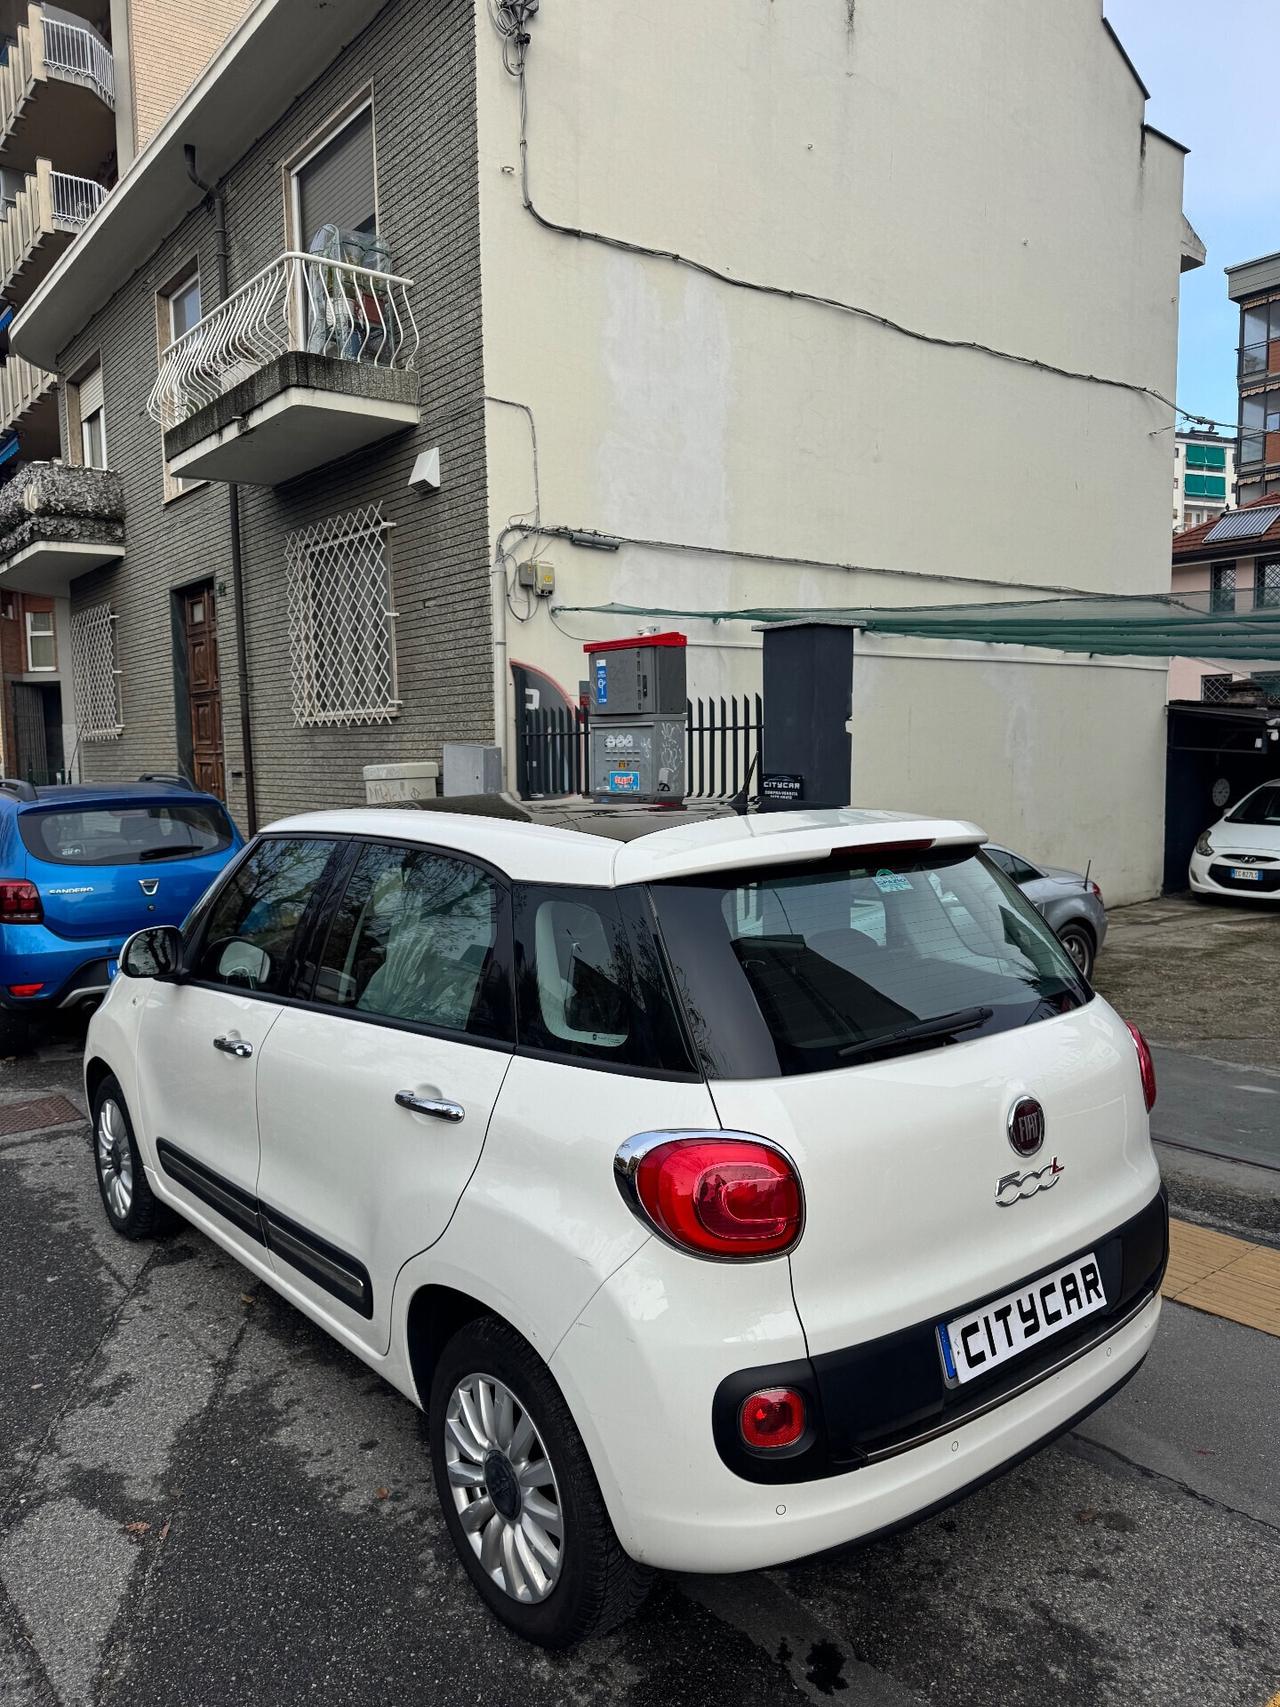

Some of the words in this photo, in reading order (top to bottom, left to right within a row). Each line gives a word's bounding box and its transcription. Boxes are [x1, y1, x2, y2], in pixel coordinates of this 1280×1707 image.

[763, 781, 800, 789] CITYCAR
[1017, 1111, 1040, 1143] FIAT
[960, 1262, 1103, 1369] CITYCAR
